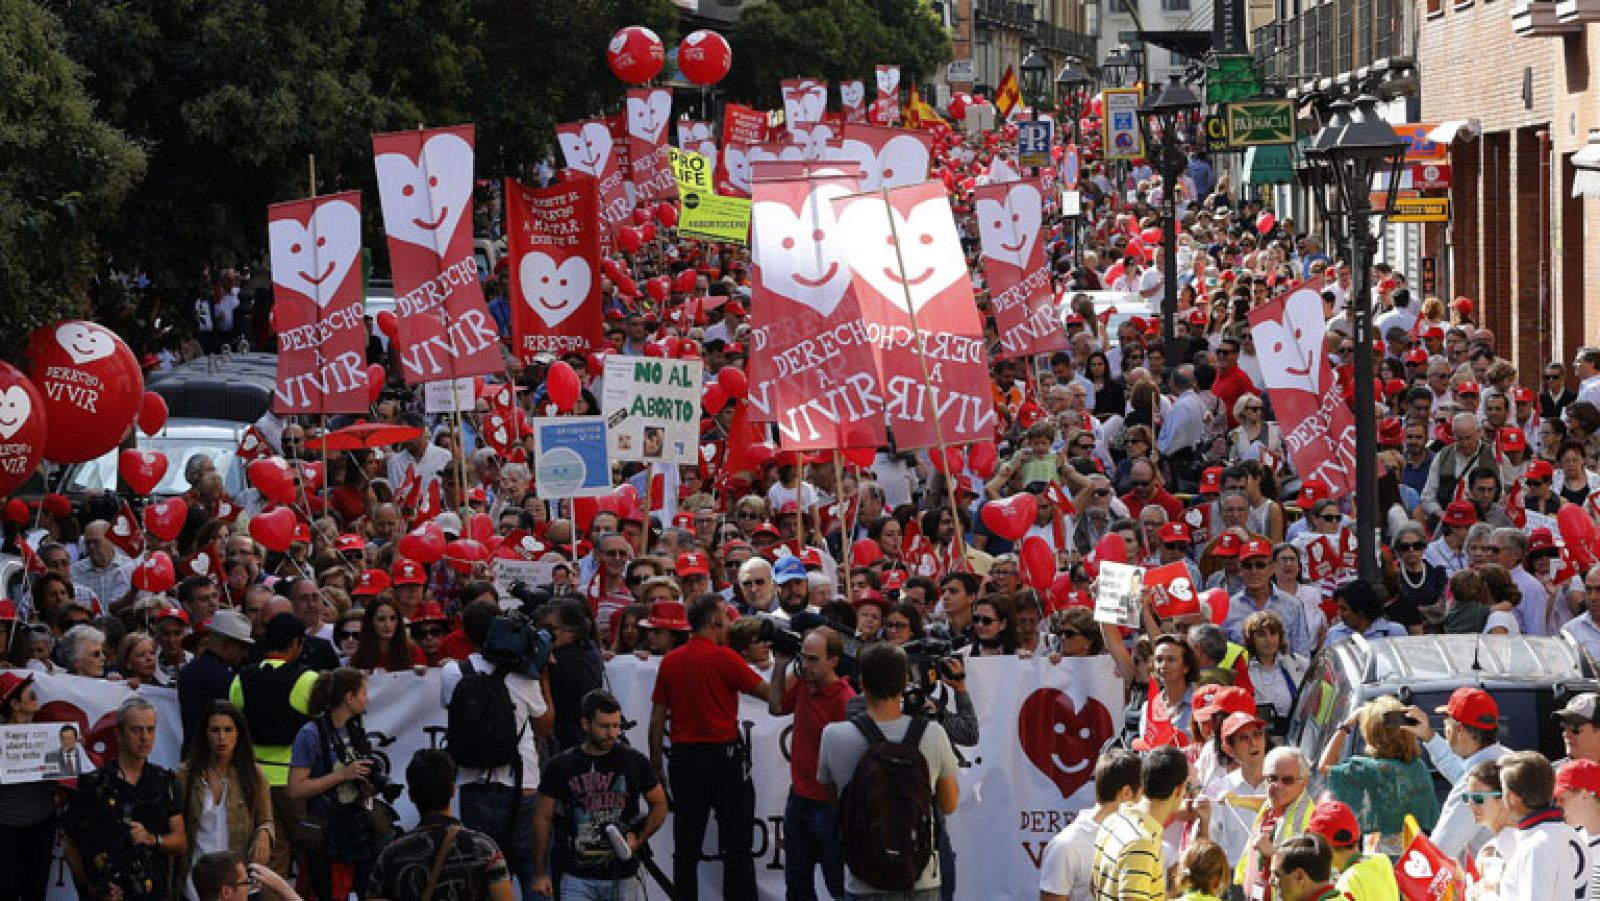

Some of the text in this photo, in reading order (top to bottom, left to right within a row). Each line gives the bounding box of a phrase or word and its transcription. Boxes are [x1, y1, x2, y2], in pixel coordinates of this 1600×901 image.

[1234, 115, 1288, 130] FARMACIA
[670, 151, 704, 171] PRO
[398, 256, 477, 318] DERECHO
[279, 302, 364, 351] DERECHO
[401, 309, 499, 376] VIVIR
[1001, 303, 1062, 352] VIVIR
[523, 335, 584, 351] DERECHO
[275, 351, 369, 408] VIVIR
[634, 362, 662, 384] NO
[668, 364, 692, 388] AL
[816, 368, 835, 388] A
[44, 381, 99, 413] VIVIR
[629, 393, 694, 423] ABORTO
[779, 372, 885, 442] VIVIR
